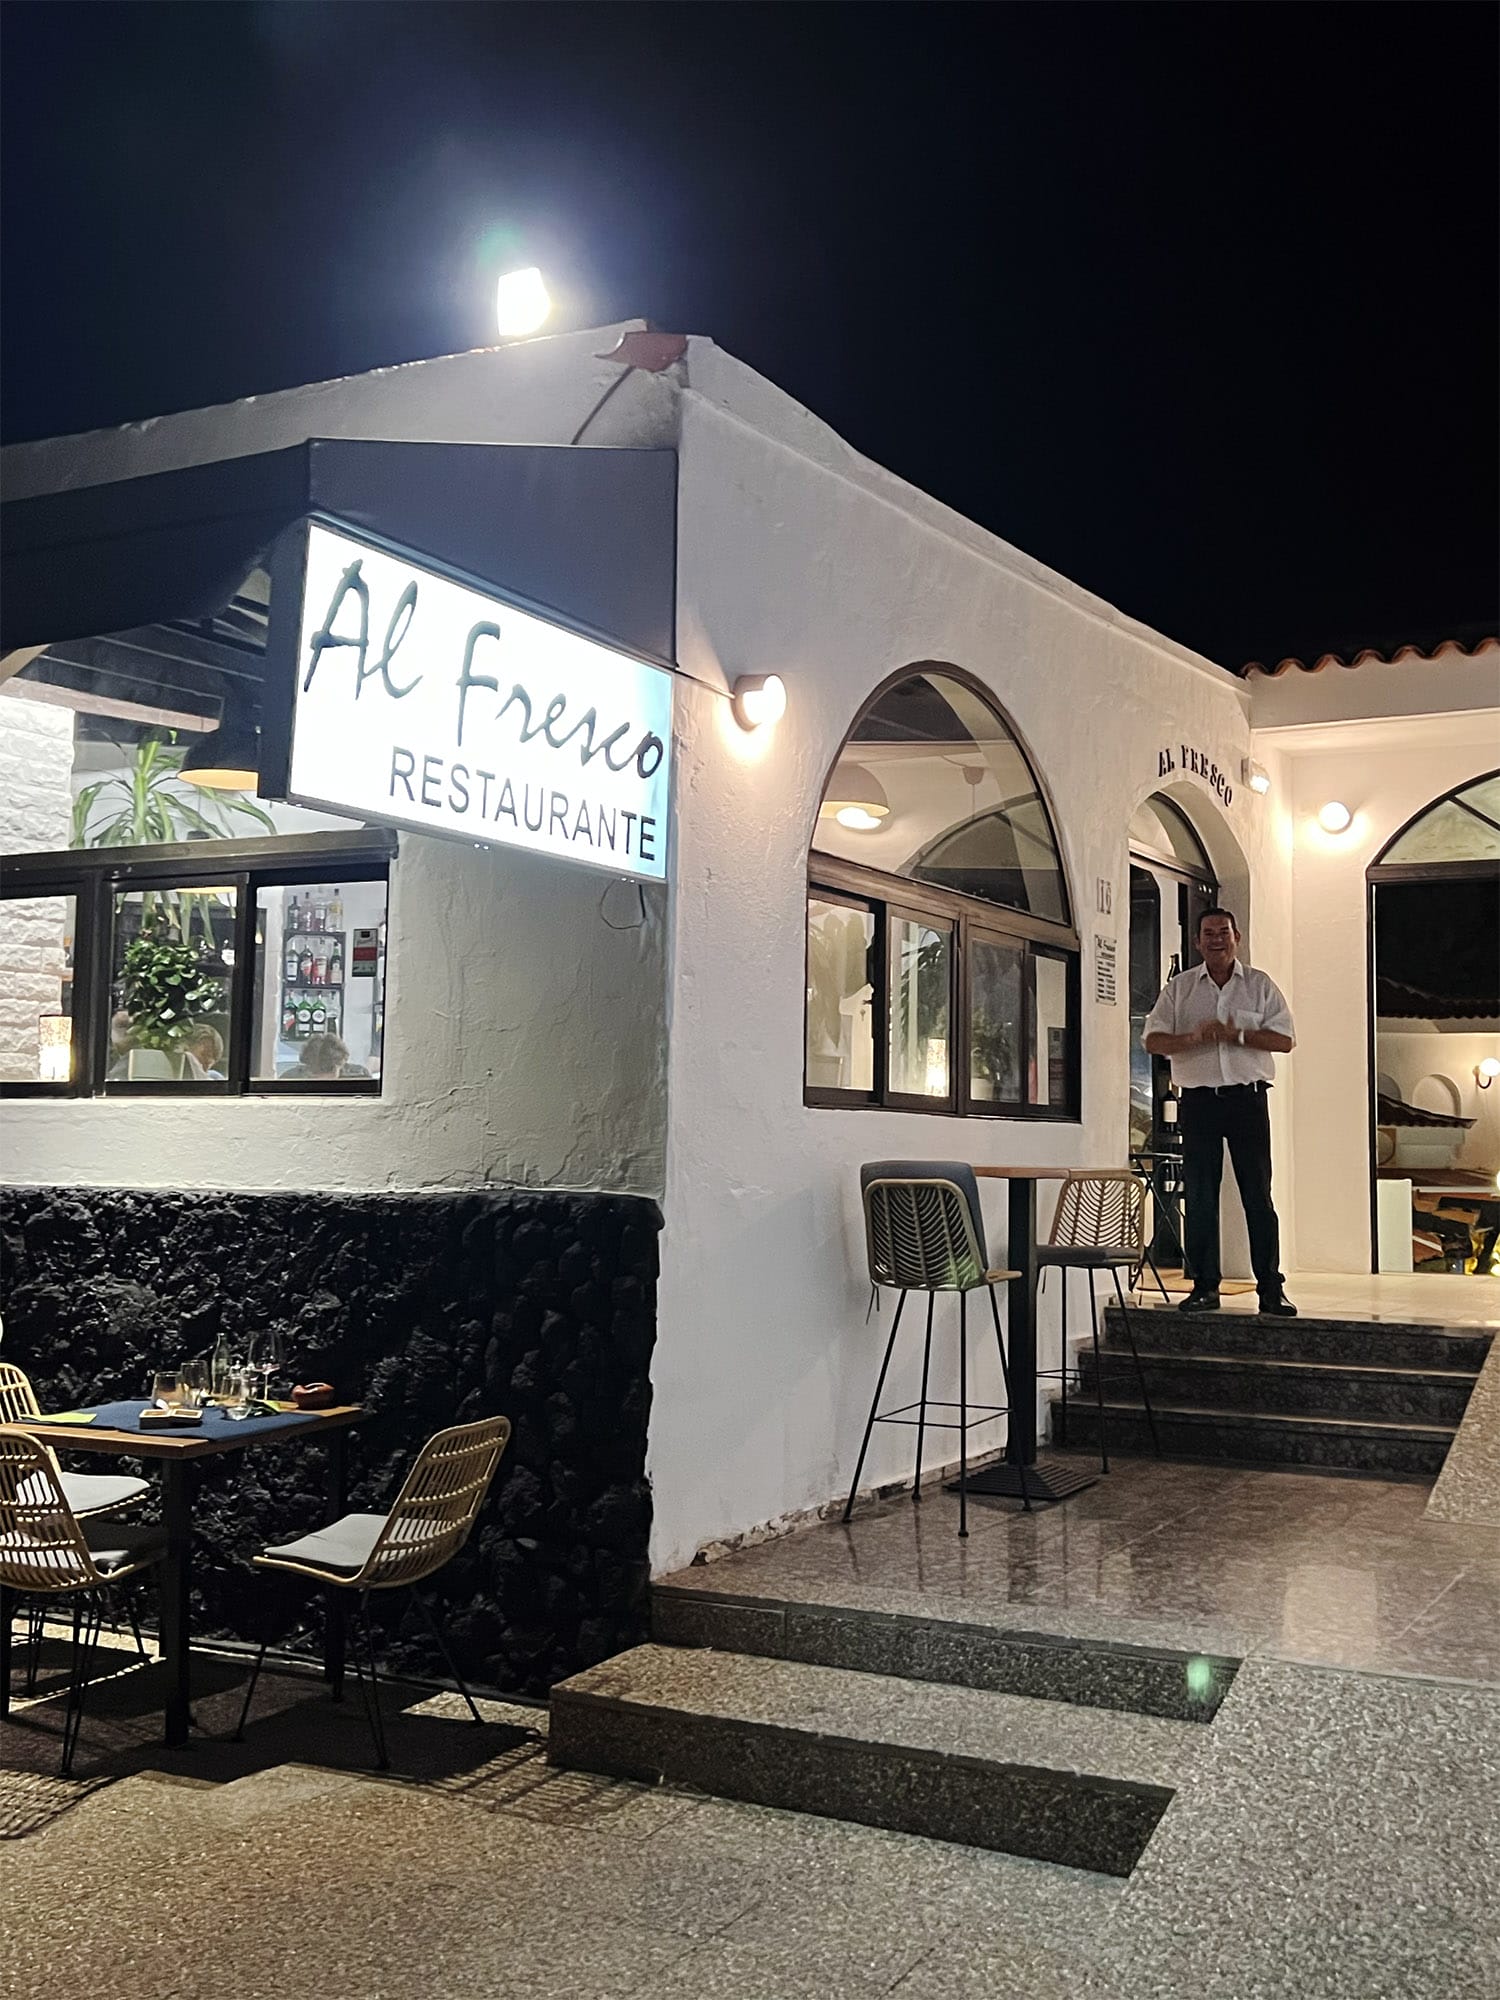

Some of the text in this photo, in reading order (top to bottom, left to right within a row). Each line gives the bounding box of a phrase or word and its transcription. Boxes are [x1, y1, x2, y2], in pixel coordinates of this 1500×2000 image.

[304, 558, 664, 779] Al Fresco
[389, 746, 656, 861] RESTAURANTE
[1158, 744, 1233, 807] AL FRESCO
